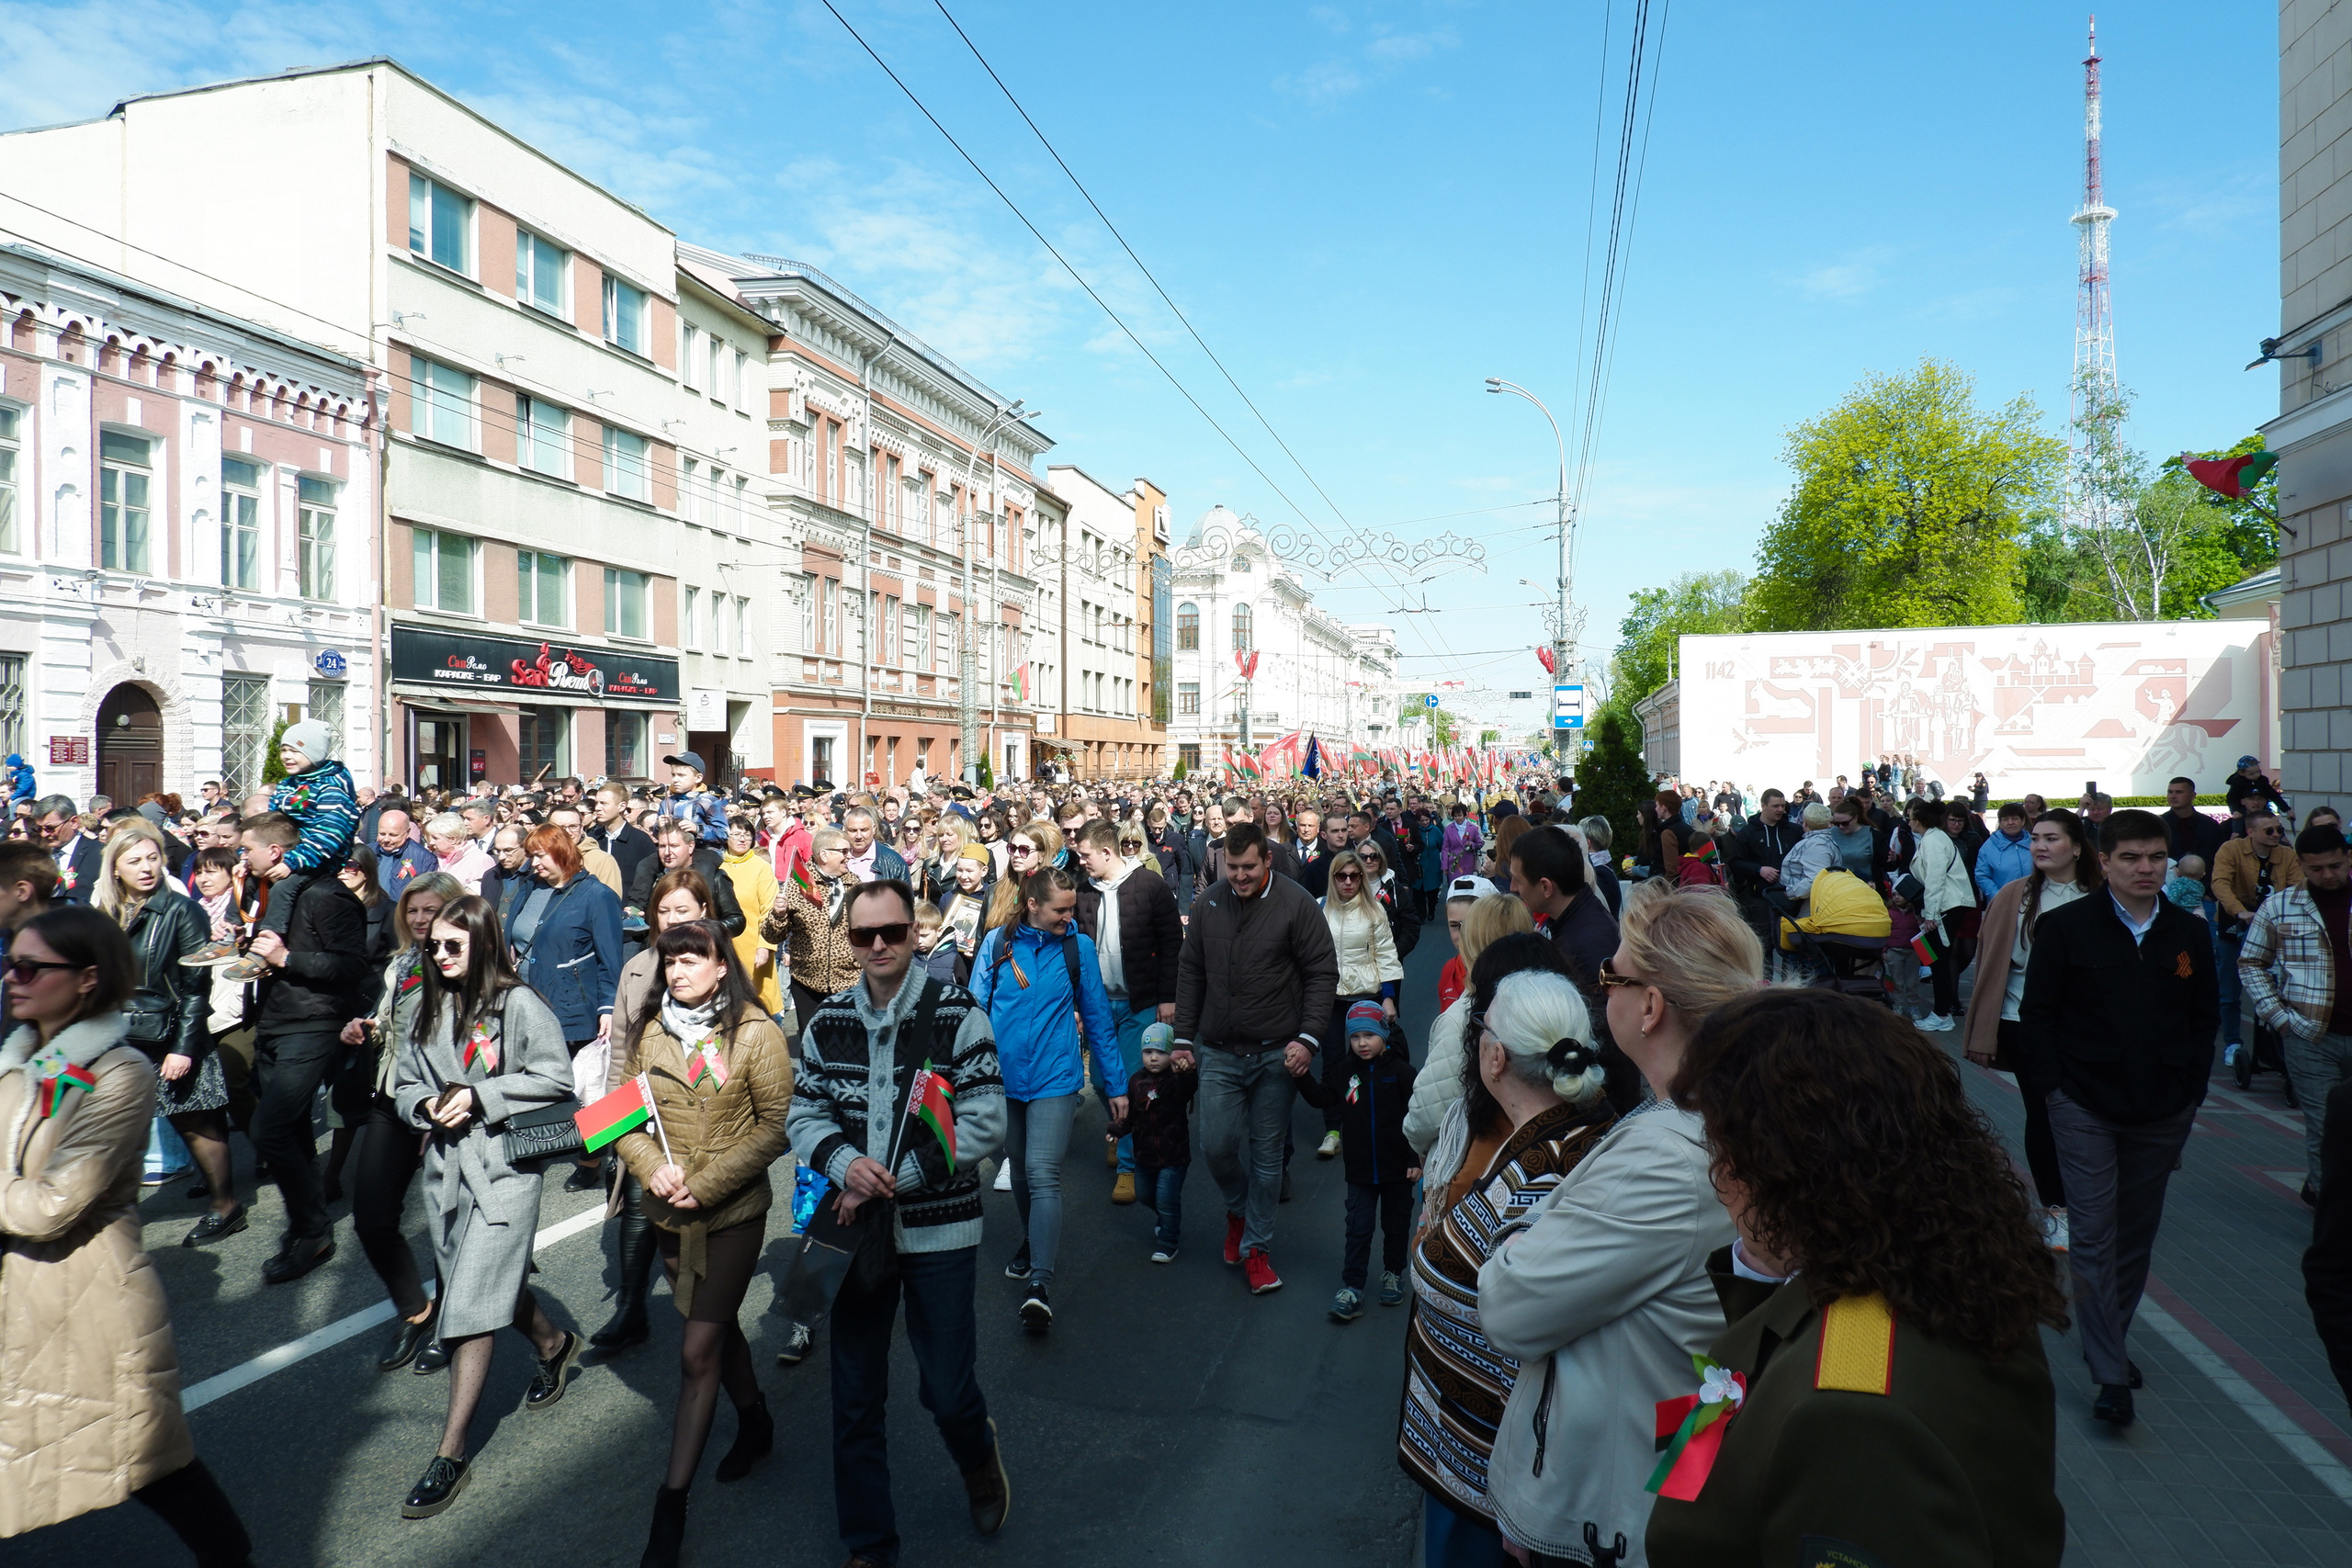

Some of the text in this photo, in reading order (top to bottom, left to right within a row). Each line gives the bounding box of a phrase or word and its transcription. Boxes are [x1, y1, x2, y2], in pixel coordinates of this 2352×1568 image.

[326, 658, 337, 669] 24
[1705, 660, 1736, 680] 1142
[483, 673, 502, 682] БАР
